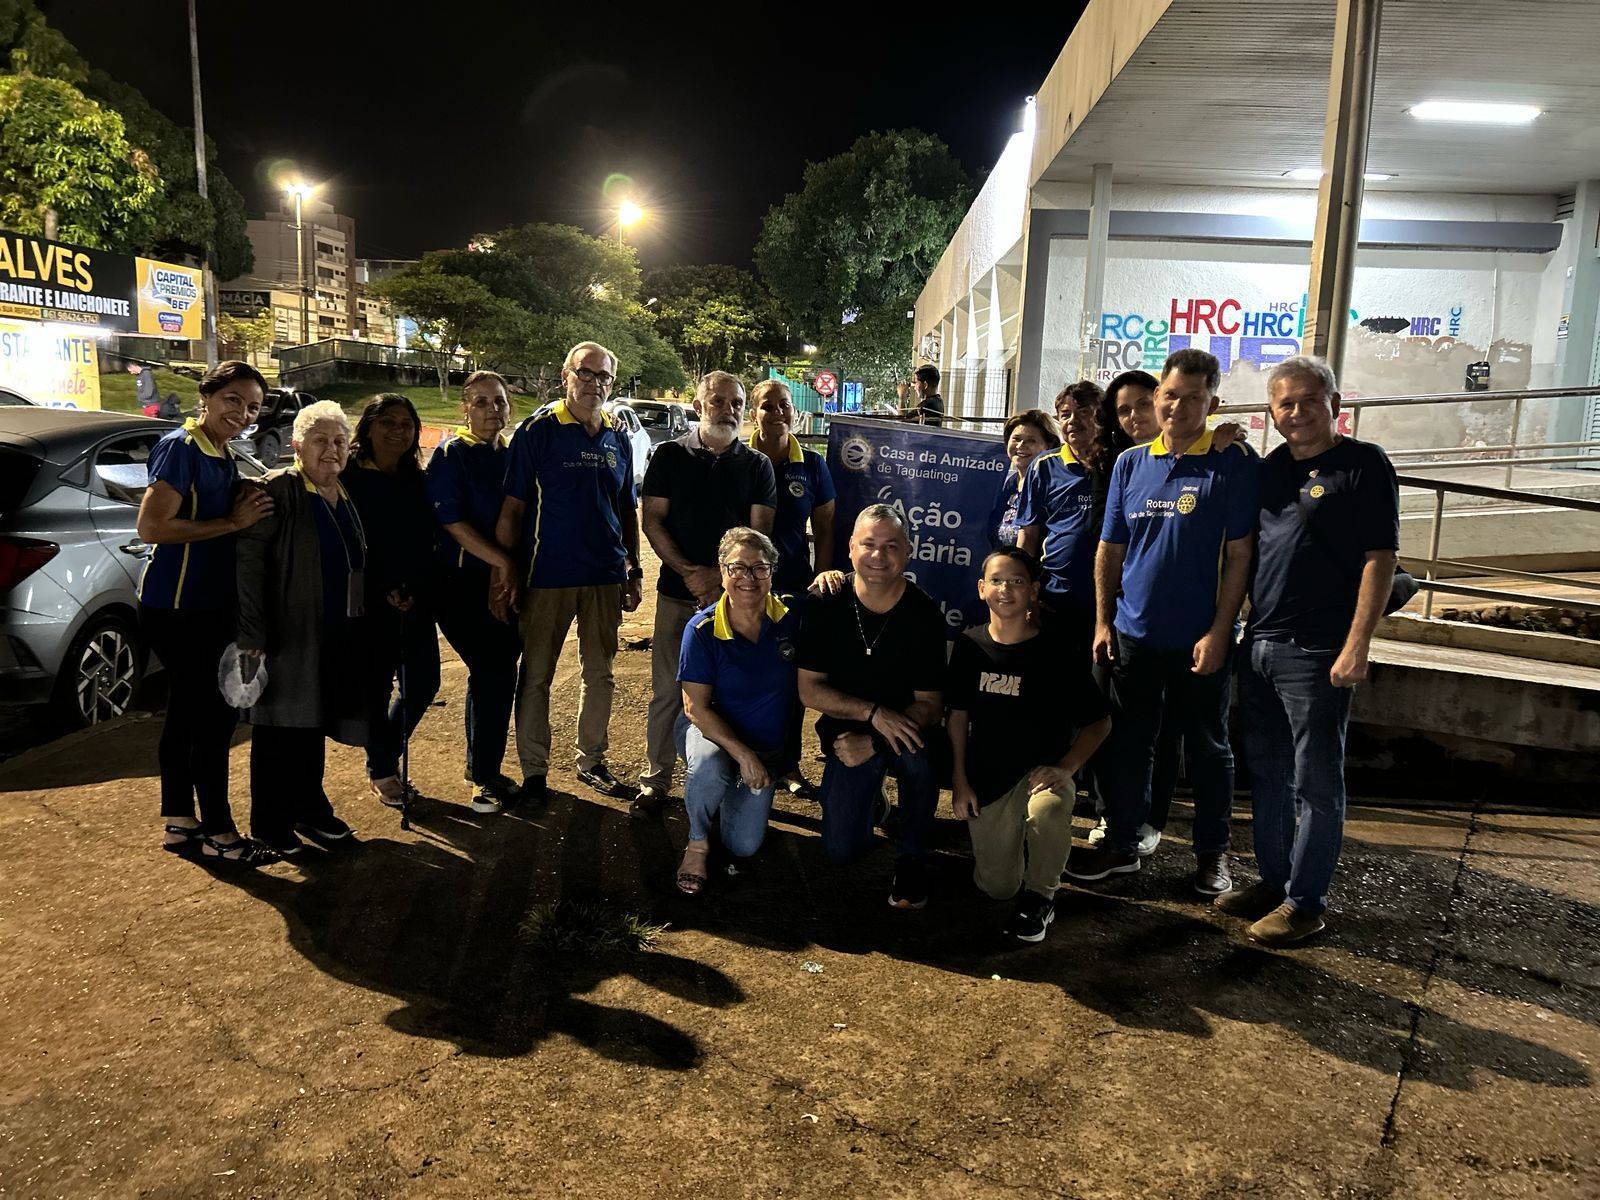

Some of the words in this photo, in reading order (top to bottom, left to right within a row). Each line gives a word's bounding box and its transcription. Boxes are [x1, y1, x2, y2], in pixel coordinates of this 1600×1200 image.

[156, 271, 194, 287] CAPITAL
[45, 288, 53, 307] E
[54, 290, 130, 317] LANCHONETE
[171, 299, 189, 310] BET
[1269, 302, 1298, 312] HRC
[1100, 313, 1144, 340] RC
[1169, 298, 1241, 335] HRC
[1243, 312, 1293, 337] HRC
[1410, 317, 1441, 336] HRC
[1449, 307, 1462, 336] HRC
[1143, 320, 1169, 369] HRC
[879, 445, 915, 461] Casa
[920, 450, 937, 464] da
[940, 453, 1004, 472] Amizade
[877, 462, 892, 474] de
[895, 463, 959, 484] Taguatinga
[1146, 499, 1176, 510] Rotary
[908, 534, 972, 566] dária
